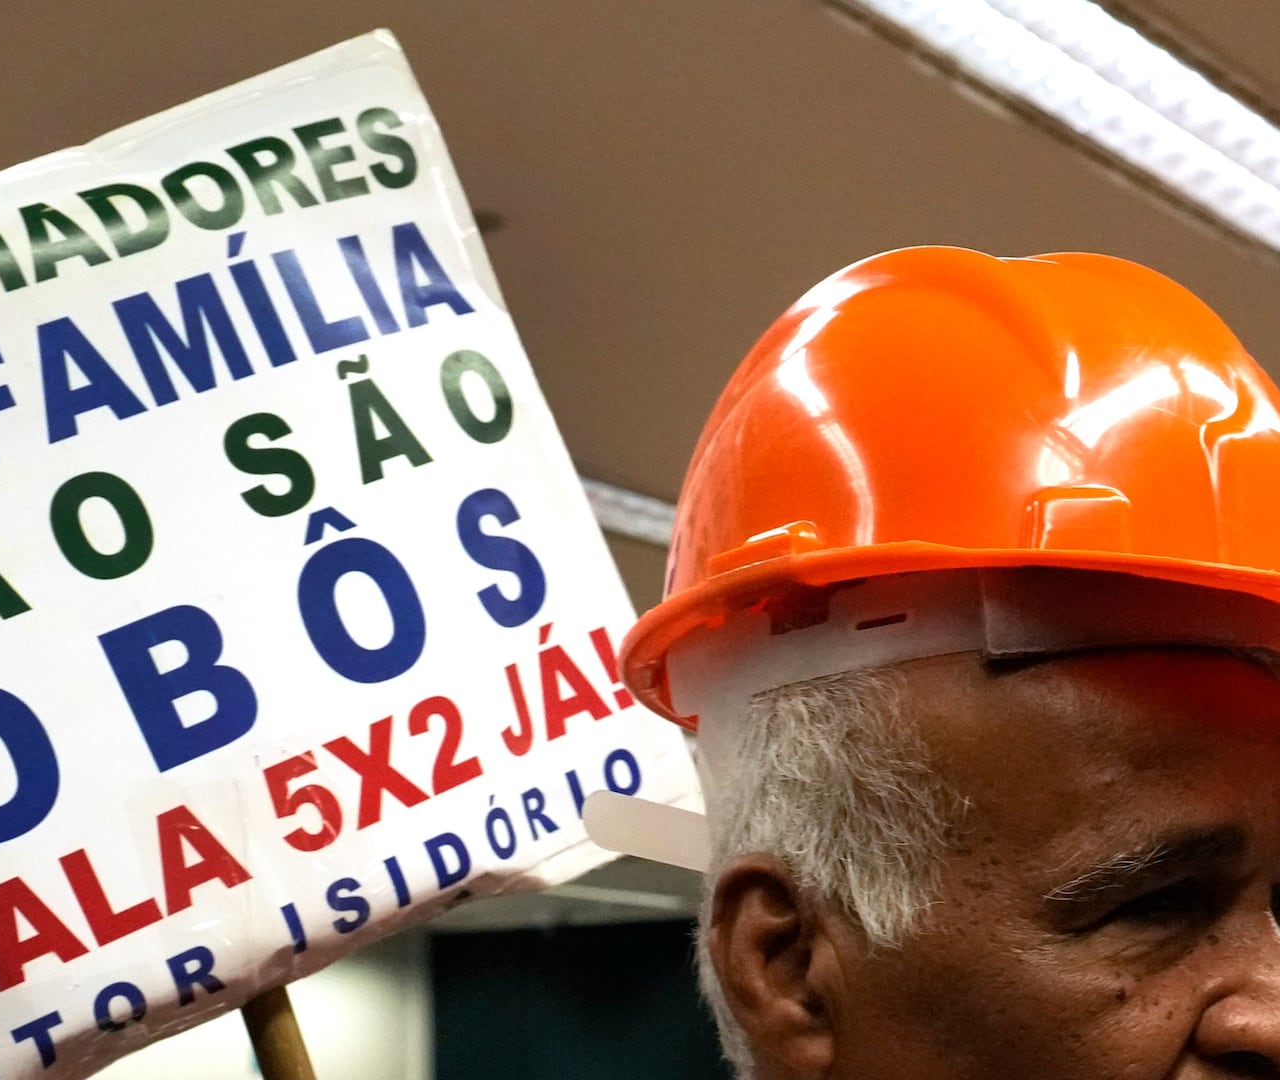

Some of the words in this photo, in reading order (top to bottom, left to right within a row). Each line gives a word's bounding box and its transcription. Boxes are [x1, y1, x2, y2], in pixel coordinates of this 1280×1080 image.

[223, 348, 513, 518] SÃO
[263, 694, 483, 853] 5X2
[500, 621, 635, 757] JÁ!
[280, 747, 643, 955] ISIDÓRIO
